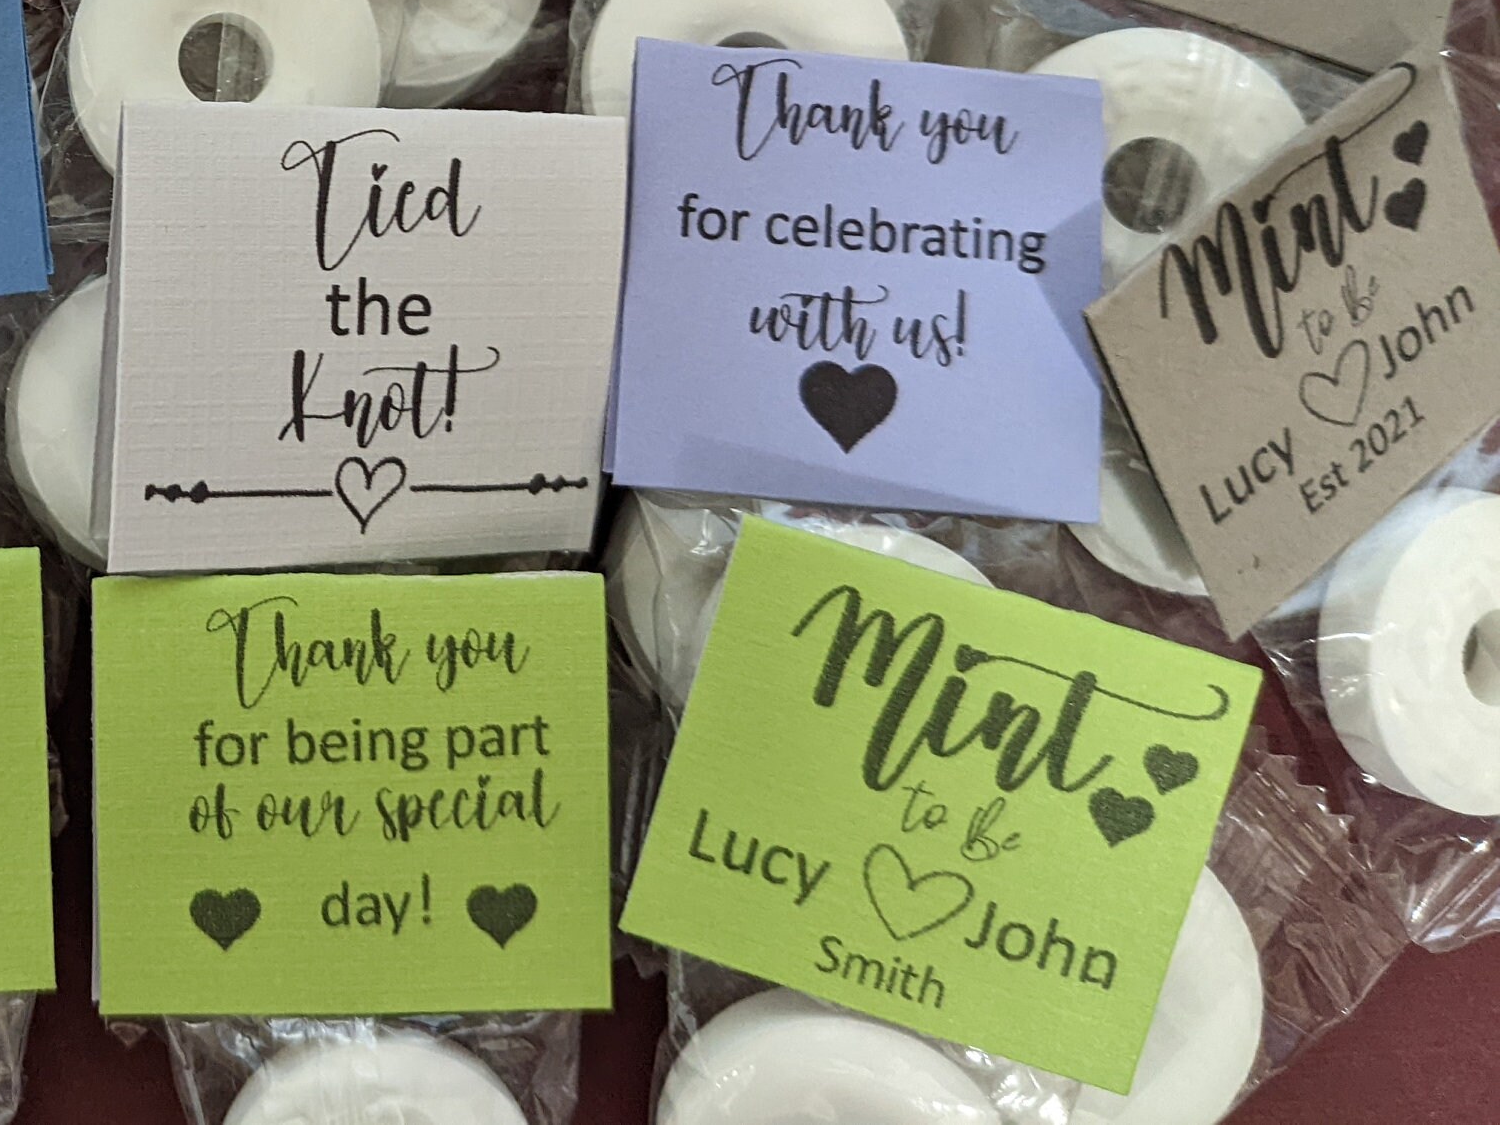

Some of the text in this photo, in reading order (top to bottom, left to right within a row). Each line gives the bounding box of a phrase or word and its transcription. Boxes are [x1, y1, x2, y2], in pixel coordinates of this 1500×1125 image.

[712, 58, 1018, 165] Thank you
[281, 129, 481, 271] Tied
[677, 193, 1047, 274] for celebrating
[1158, 62, 1416, 359] Mint
[325, 277, 432, 336] the
[749, 285, 966, 367] with us!
[1296, 309, 1336, 356] to
[278, 344, 500, 449] Knot!
[1199, 286, 1475, 525] Lucy John
[1299, 396, 1425, 515] Est 2021
[206, 596, 530, 710] Thank you
[791, 584, 1230, 793] Mint
[193, 715, 550, 772] for being part
[189, 767, 560, 843] of our special
[901, 780, 948, 833] to
[321, 873, 431, 936] day!
[688, 808, 1118, 990] Lucy John
[814, 935, 945, 1009] Smith
